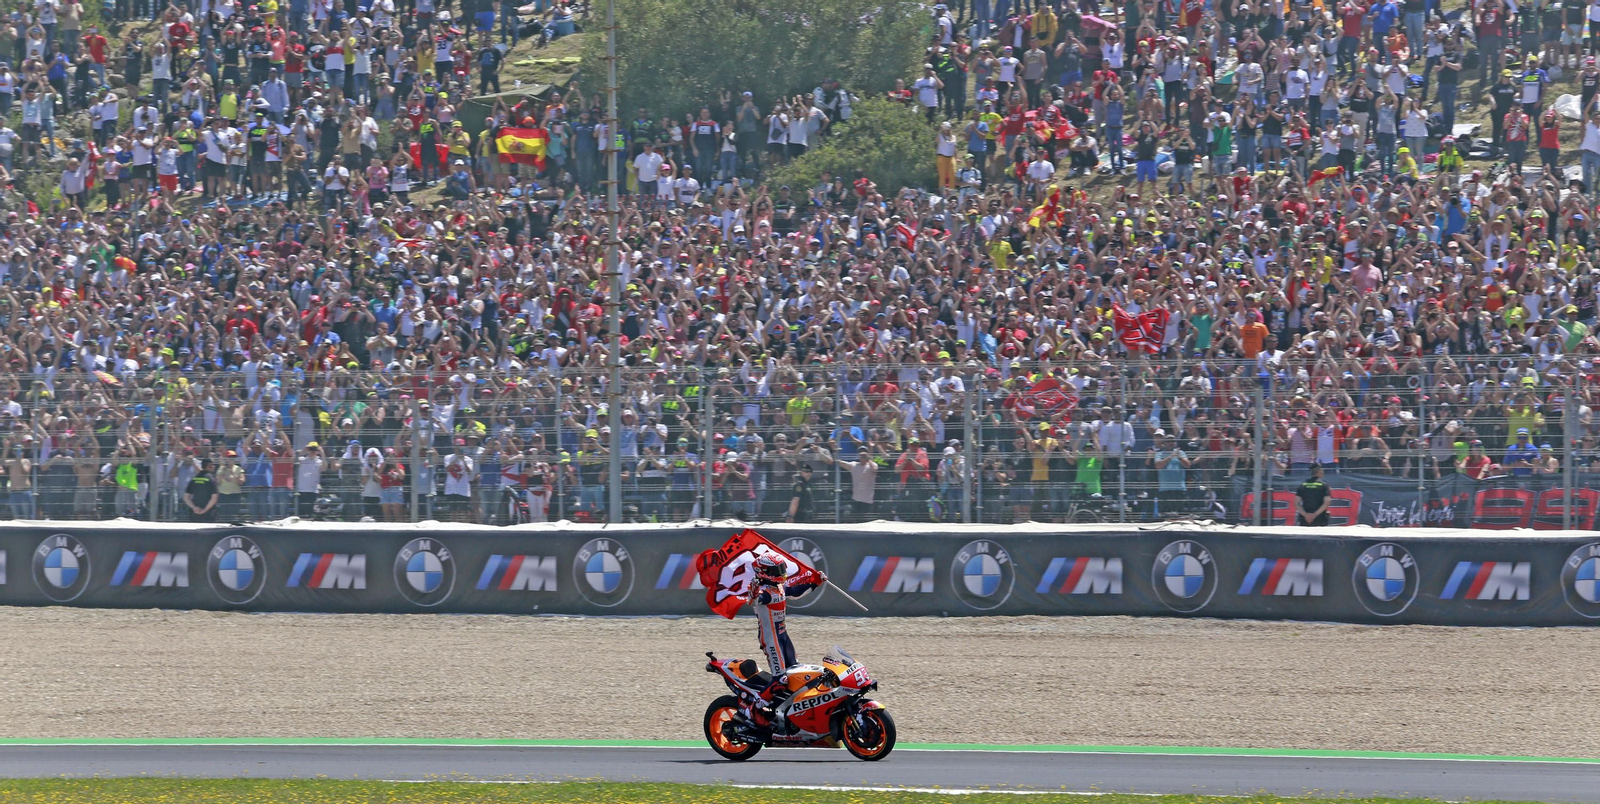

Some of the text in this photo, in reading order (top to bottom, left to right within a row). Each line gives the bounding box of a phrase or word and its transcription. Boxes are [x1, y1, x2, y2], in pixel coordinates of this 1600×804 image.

[38, 536, 86, 558] BMW
[213, 537, 261, 559] BMW
[401, 540, 450, 562] BMW
[579, 540, 628, 562] BMW
[958, 542, 1009, 565] BMW
[1159, 543, 1211, 565] BMW
[1359, 546, 1413, 568] BMW
[1569, 545, 1600, 568] BM
[769, 646, 781, 675] REPSOL
[792, 691, 839, 711] REPSOL
